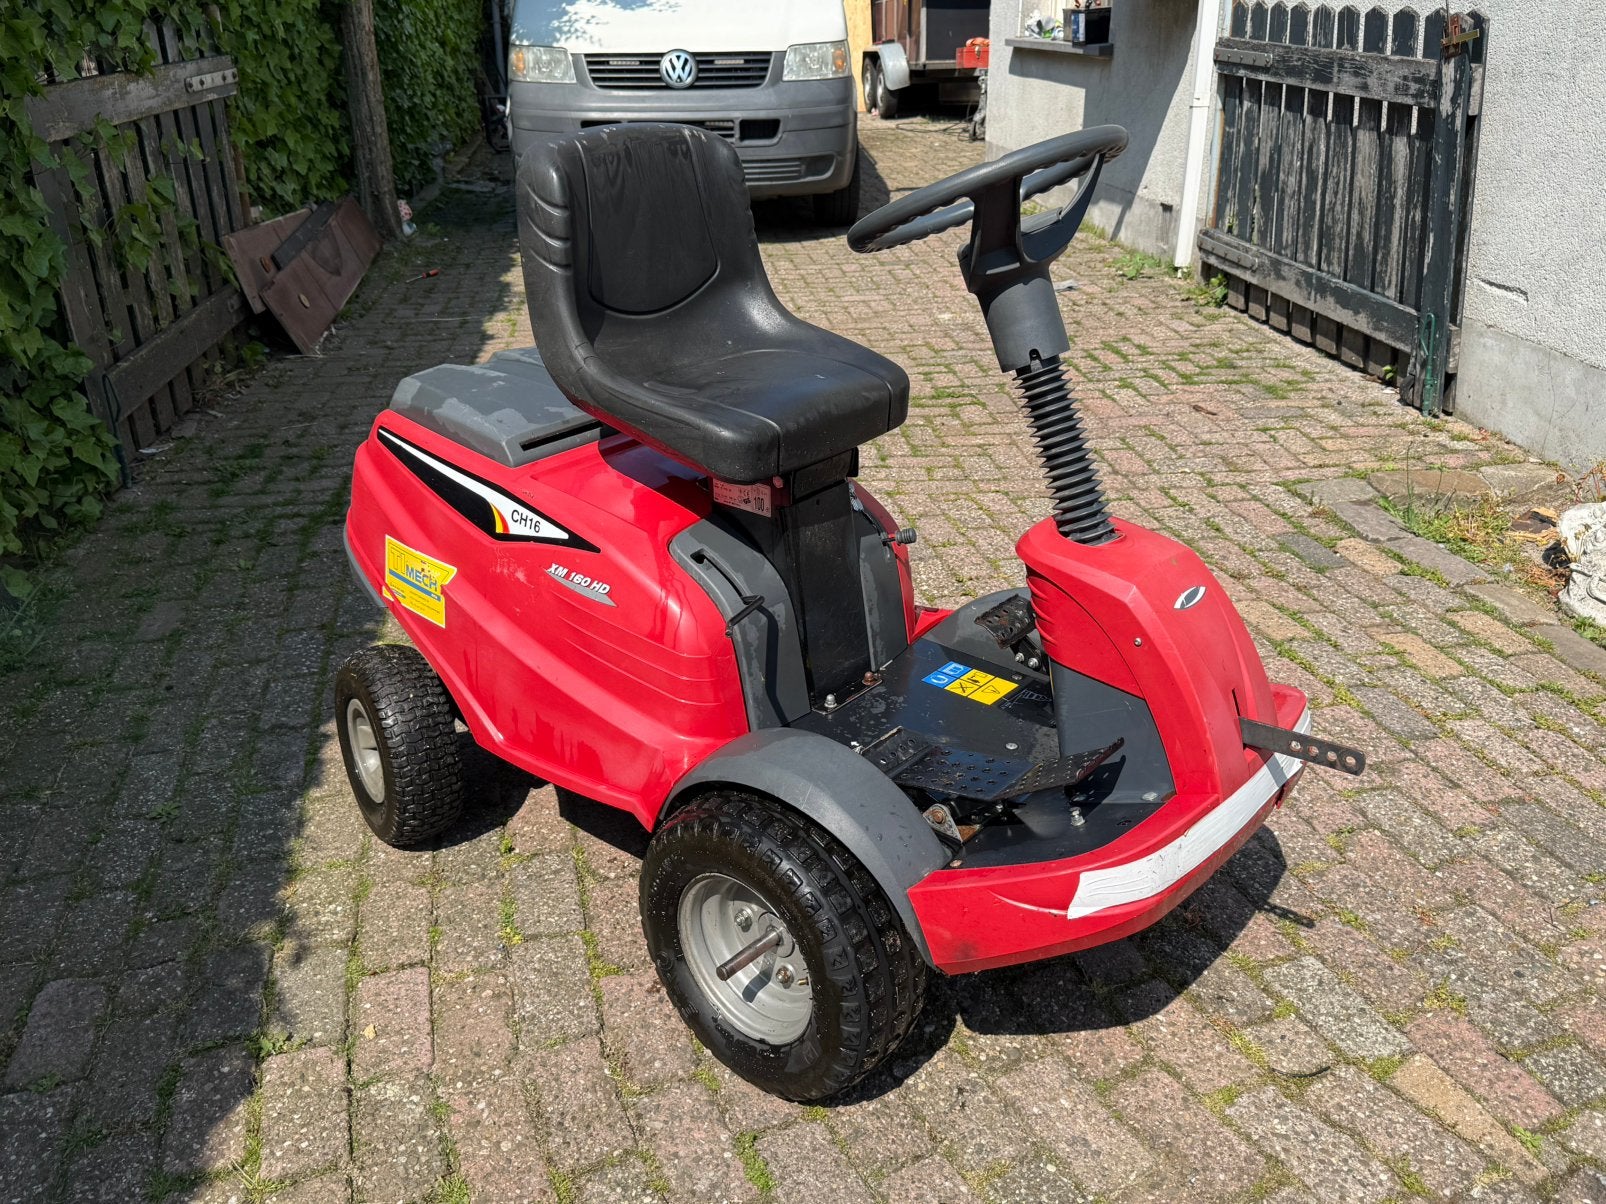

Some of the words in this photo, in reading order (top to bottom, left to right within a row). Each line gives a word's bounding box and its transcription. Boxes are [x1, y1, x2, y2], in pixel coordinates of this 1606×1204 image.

[662, 51, 695, 87] VW
[511, 509, 541, 533] CH16
[547, 563, 569, 578] XM
[569, 572, 592, 587] 160
[590, 580, 611, 594] HD
